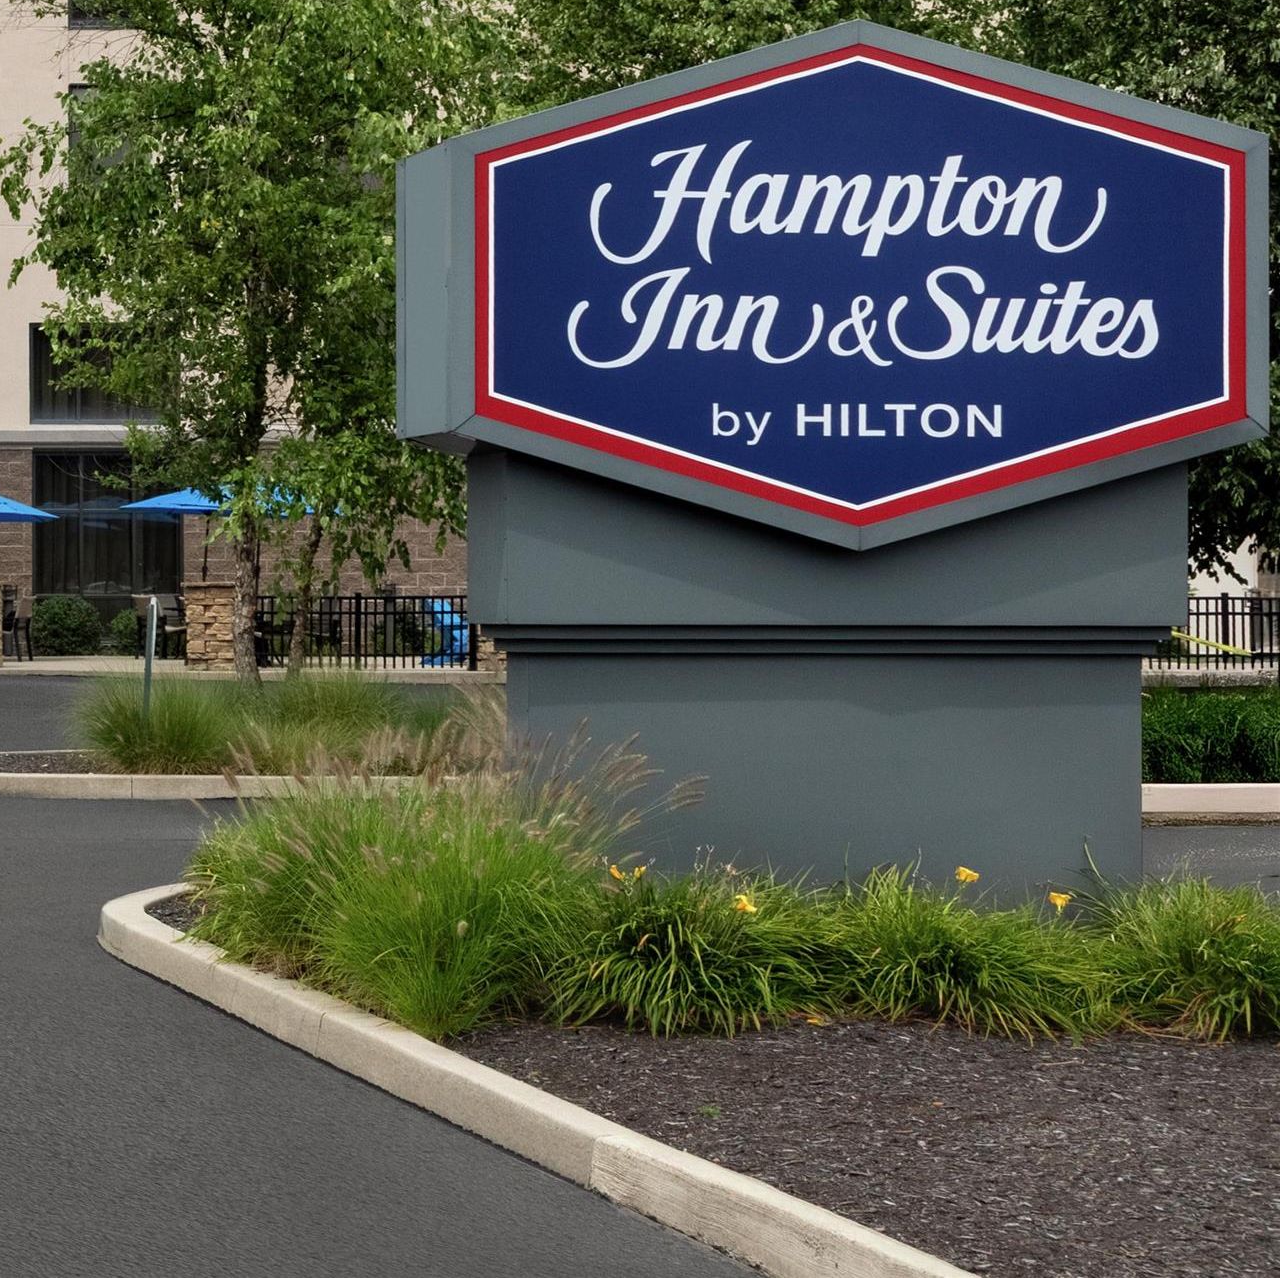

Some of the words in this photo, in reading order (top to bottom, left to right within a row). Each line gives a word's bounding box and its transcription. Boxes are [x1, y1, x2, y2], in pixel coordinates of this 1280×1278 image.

[589, 139, 1108, 265] Hampton
[566, 266, 824, 370] Inn
[827, 294, 894, 367] &
[887, 265, 1160, 360] Suites
[711, 402, 772, 446] by
[796, 403, 1003, 438] HILTON
